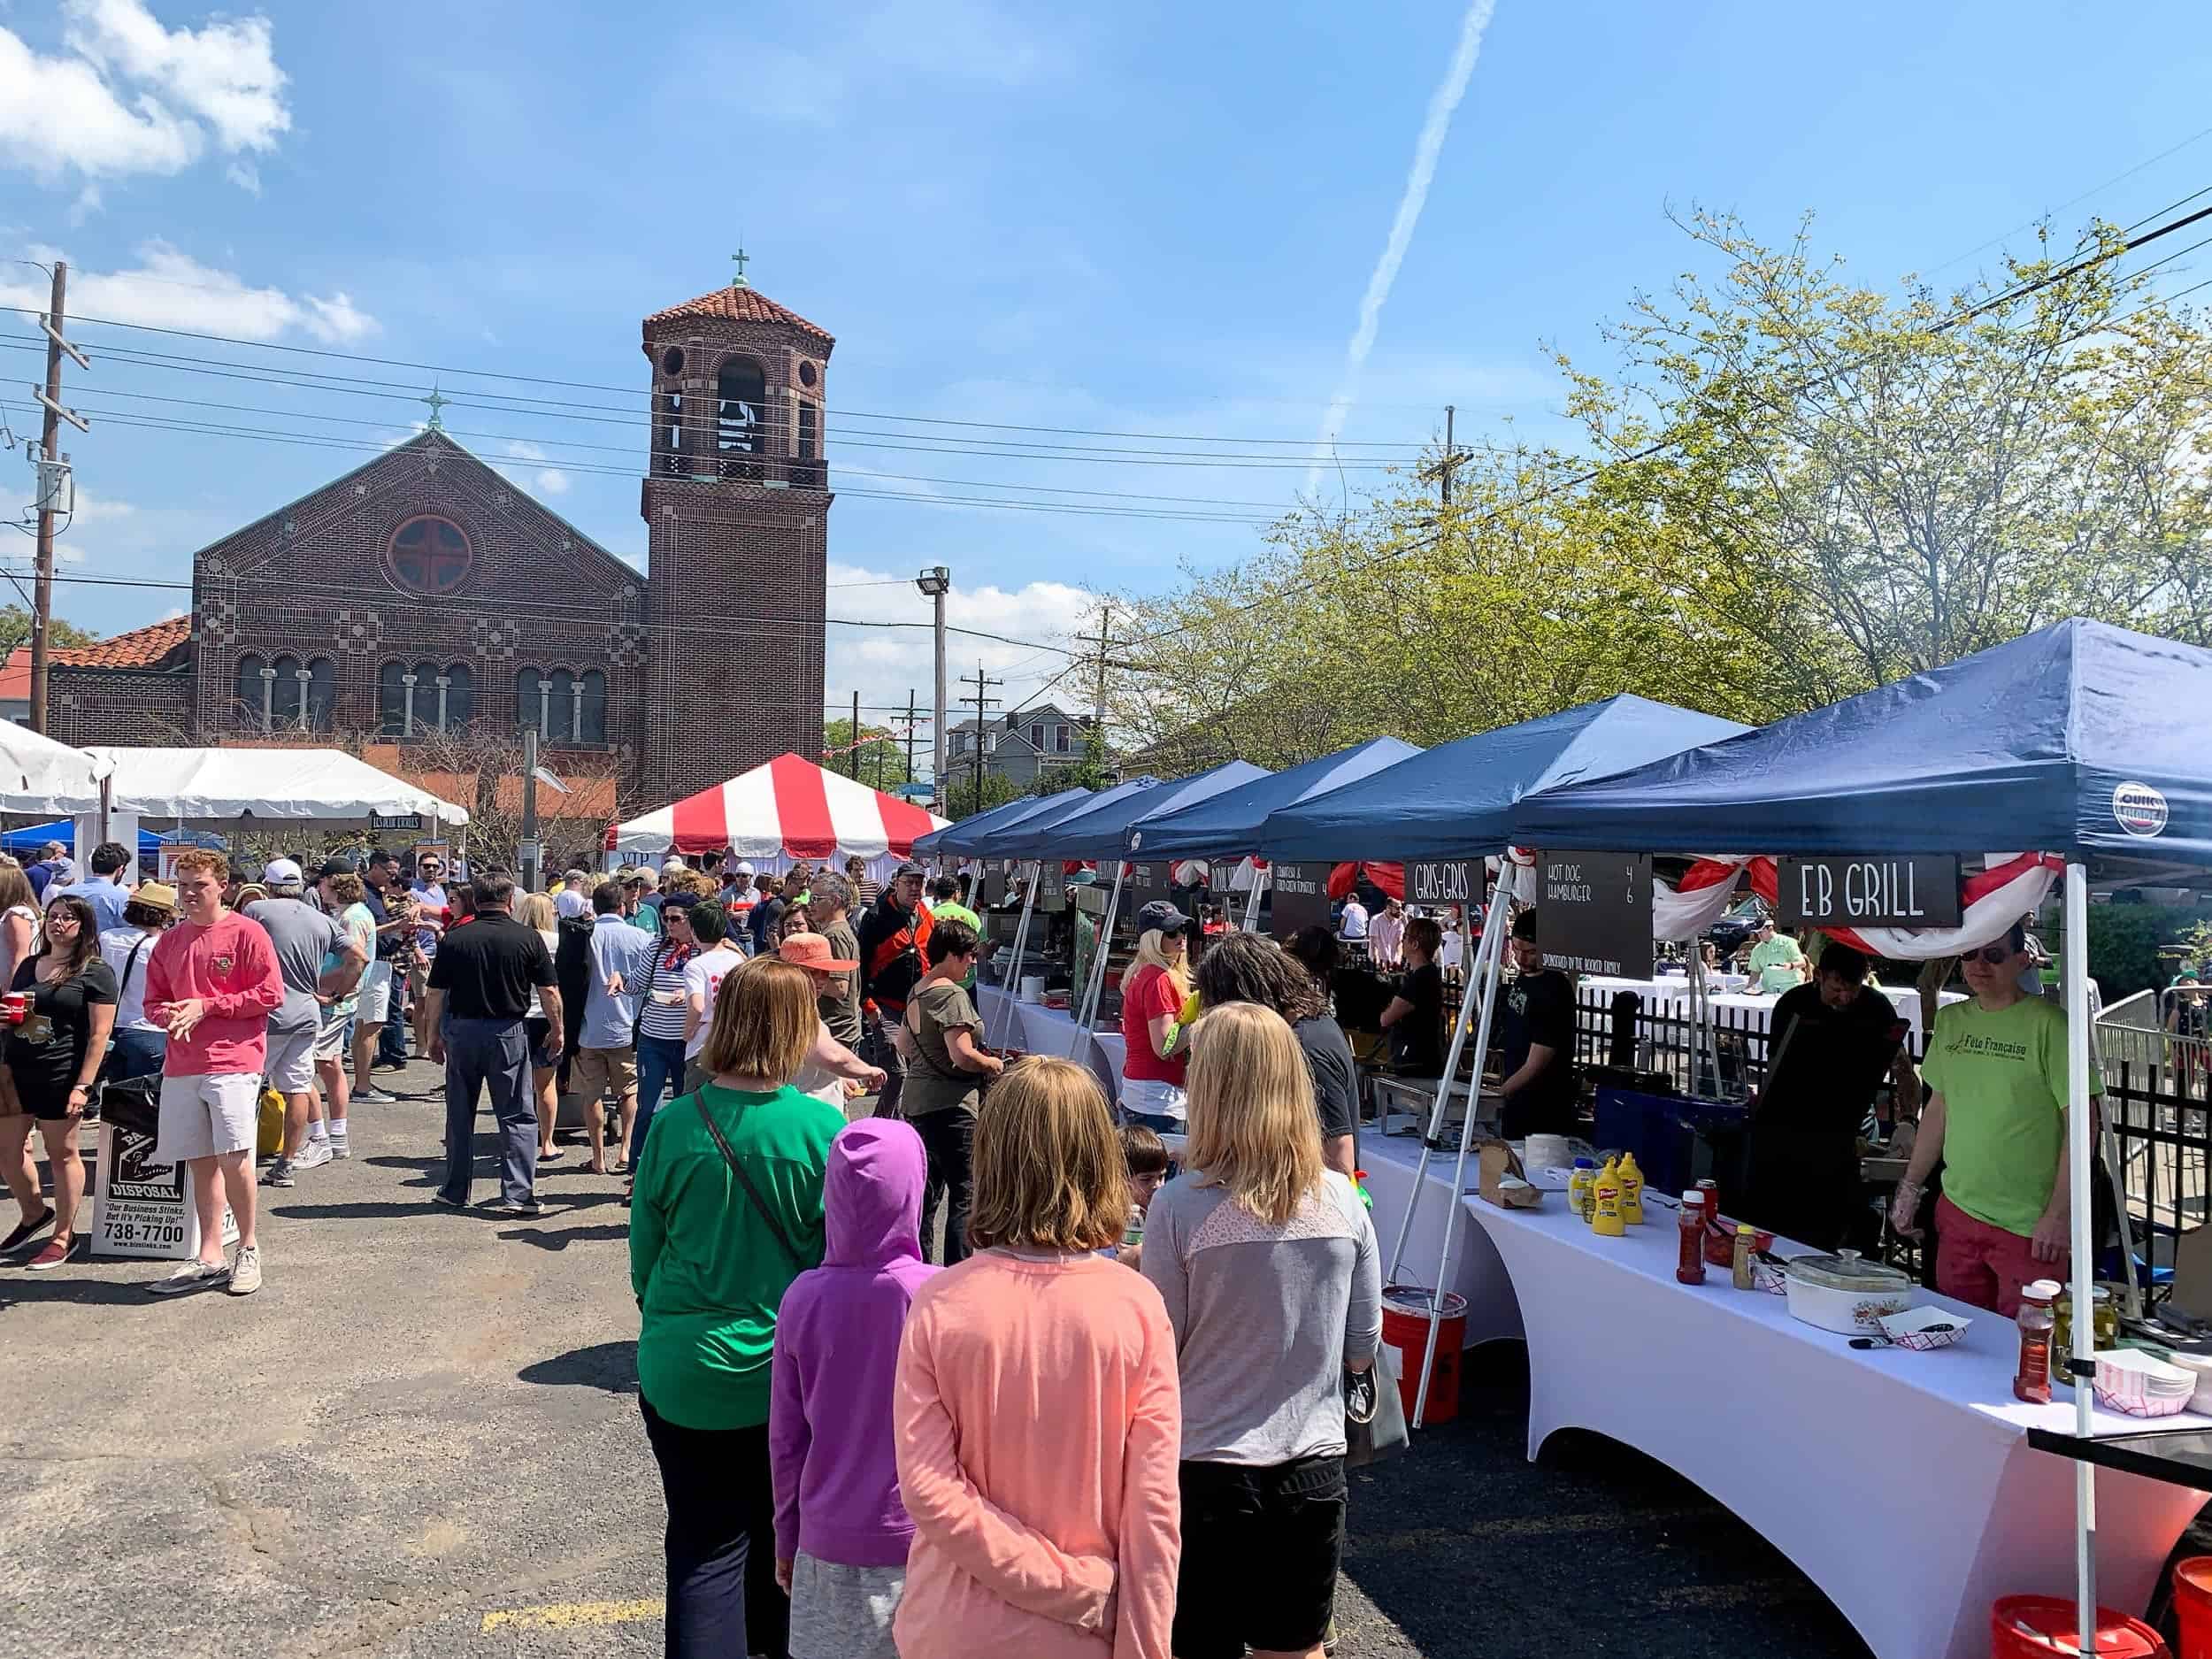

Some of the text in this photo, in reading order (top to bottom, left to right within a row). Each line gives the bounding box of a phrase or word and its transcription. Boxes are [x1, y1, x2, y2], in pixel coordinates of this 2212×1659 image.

[622, 852, 649, 866] VIP
[1415, 863, 1469, 900] GRIS-GRIS
[1548, 864, 1633, 883] HOT DOG 4
[1548, 884, 1633, 904] HAMBURGER 6
[1801, 862, 1924, 917] EB GRILL
[111, 1184, 181, 1199] DISPOSAL
[105, 1212, 120, 1221] But
[134, 1214, 164, 1225] Picking
[123, 1204, 157, 1214] Business
[159, 1206, 185, 1216] Stinks,
[104, 1223, 184, 1242] 738-7700
